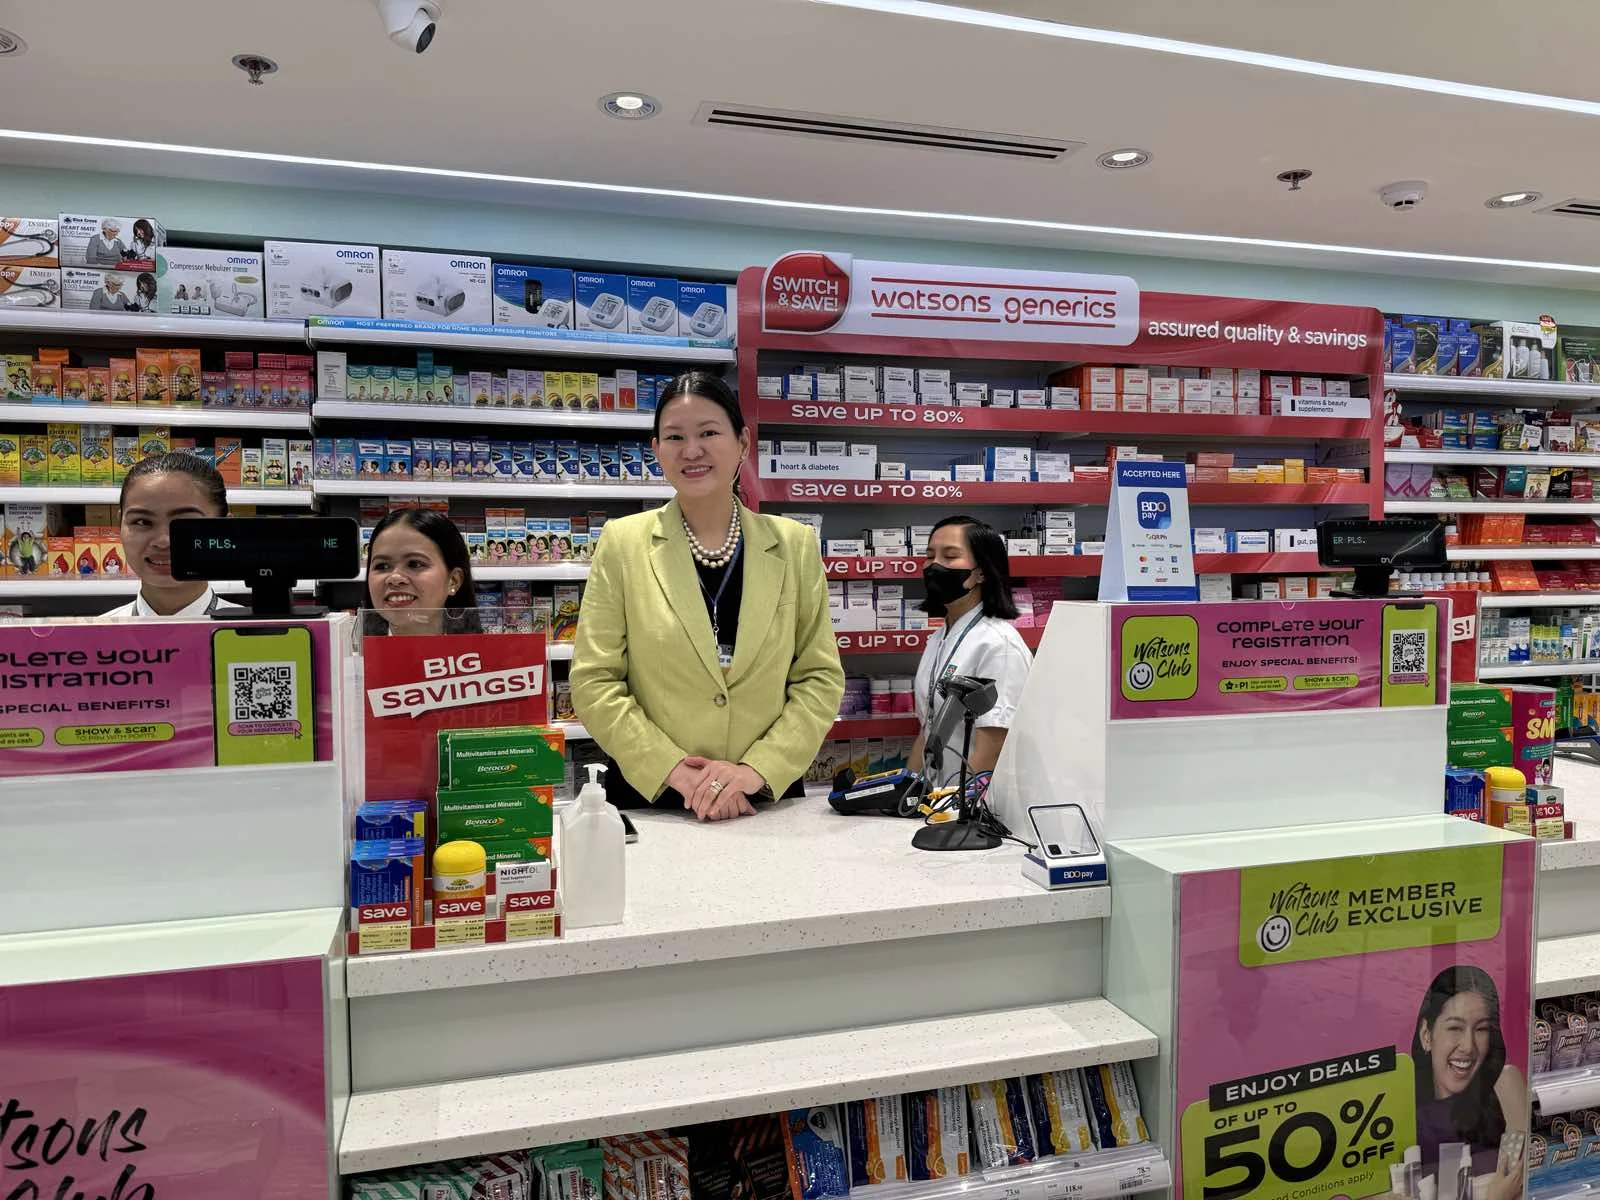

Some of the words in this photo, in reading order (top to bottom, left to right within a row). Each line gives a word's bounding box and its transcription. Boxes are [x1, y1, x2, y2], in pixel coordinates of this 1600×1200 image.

[227, 256, 258, 265] OMRON
[336, 250, 374, 260] OMRON
[169, 261, 204, 272] Compressor
[205, 263, 232, 272] Nebulizer
[450, 260, 486, 270] OMRON
[498, 268, 528, 277] OMRON
[578, 276, 605, 284] OMRON
[630, 279, 656, 288] OMRON
[772, 276, 839, 295] SWITCH
[680, 286, 706, 294] OMRON
[778, 293, 789, 306] &
[790, 294, 839, 313] SAVE!
[871, 290, 992, 313] watsons
[1004, 297, 1116, 324] generics
[1148, 320, 1219, 339] assured
[1224, 324, 1283, 345] quality
[1288, 326, 1300, 343] &
[1304, 328, 1367, 351] savings
[889, 409, 917, 422] TO
[923, 410, 964, 423] 80%
[780, 463, 800, 471] heart
[808, 463, 840, 471] diabetes
[1122, 470, 1161, 478] ACCEPTED
[1162, 471, 1181, 479] HERE
[889, 485, 916, 498] TO
[923, 485, 963, 498] 80%
[1141, 502, 1167, 512] BDO
[1142, 512, 1157, 520] pay
[209, 539, 237, 549] PLS.
[1333, 536, 1344, 544] ER
[890, 561, 917, 573] TO
[893, 634, 919, 647] TO
[1134, 637, 1190, 661] Watsons
[424, 653, 482, 679] BIG
[1157, 658, 1191, 678] Club
[1222, 659, 1258, 668] ENJOY
[1260, 658, 1304, 667] SPECIAL
[1307, 656, 1358, 665] BENEFITS!
[78, 699, 171, 712] BENEFITS!
[75, 727, 112, 736] SHOW
[456, 749, 497, 758] Multivitamins
[478, 765, 511, 773] Berocca
[444, 802, 485, 811] Multivitamins
[1544, 807, 1555, 815] 10
[465, 818, 498, 826] Berocca
[1064, 871, 1080, 879] BDO
[1081, 870, 1093, 879] pay
[510, 895, 551, 908] save
[1269, 882, 1341, 915] Watsons
[1349, 881, 1456, 907] MEMBER
[363, 906, 408, 919] save
[439, 901, 482, 914] save
[1295, 911, 1339, 936] Club
[1347, 897, 1482, 927] EXCLUSIVE
[1225, 1073, 1302, 1103] ENJOY
[1309, 1053, 1381, 1083] DEALS
[1214, 1115, 1238, 1130] OF
[1244, 1108, 1268, 1122] UP
[1274, 1101, 1297, 1115] TO
[1342, 1141, 1395, 1168] OFF
[1292, 1181, 1345, 1200] Conditions
[1348, 1171, 1374, 1185] apply
